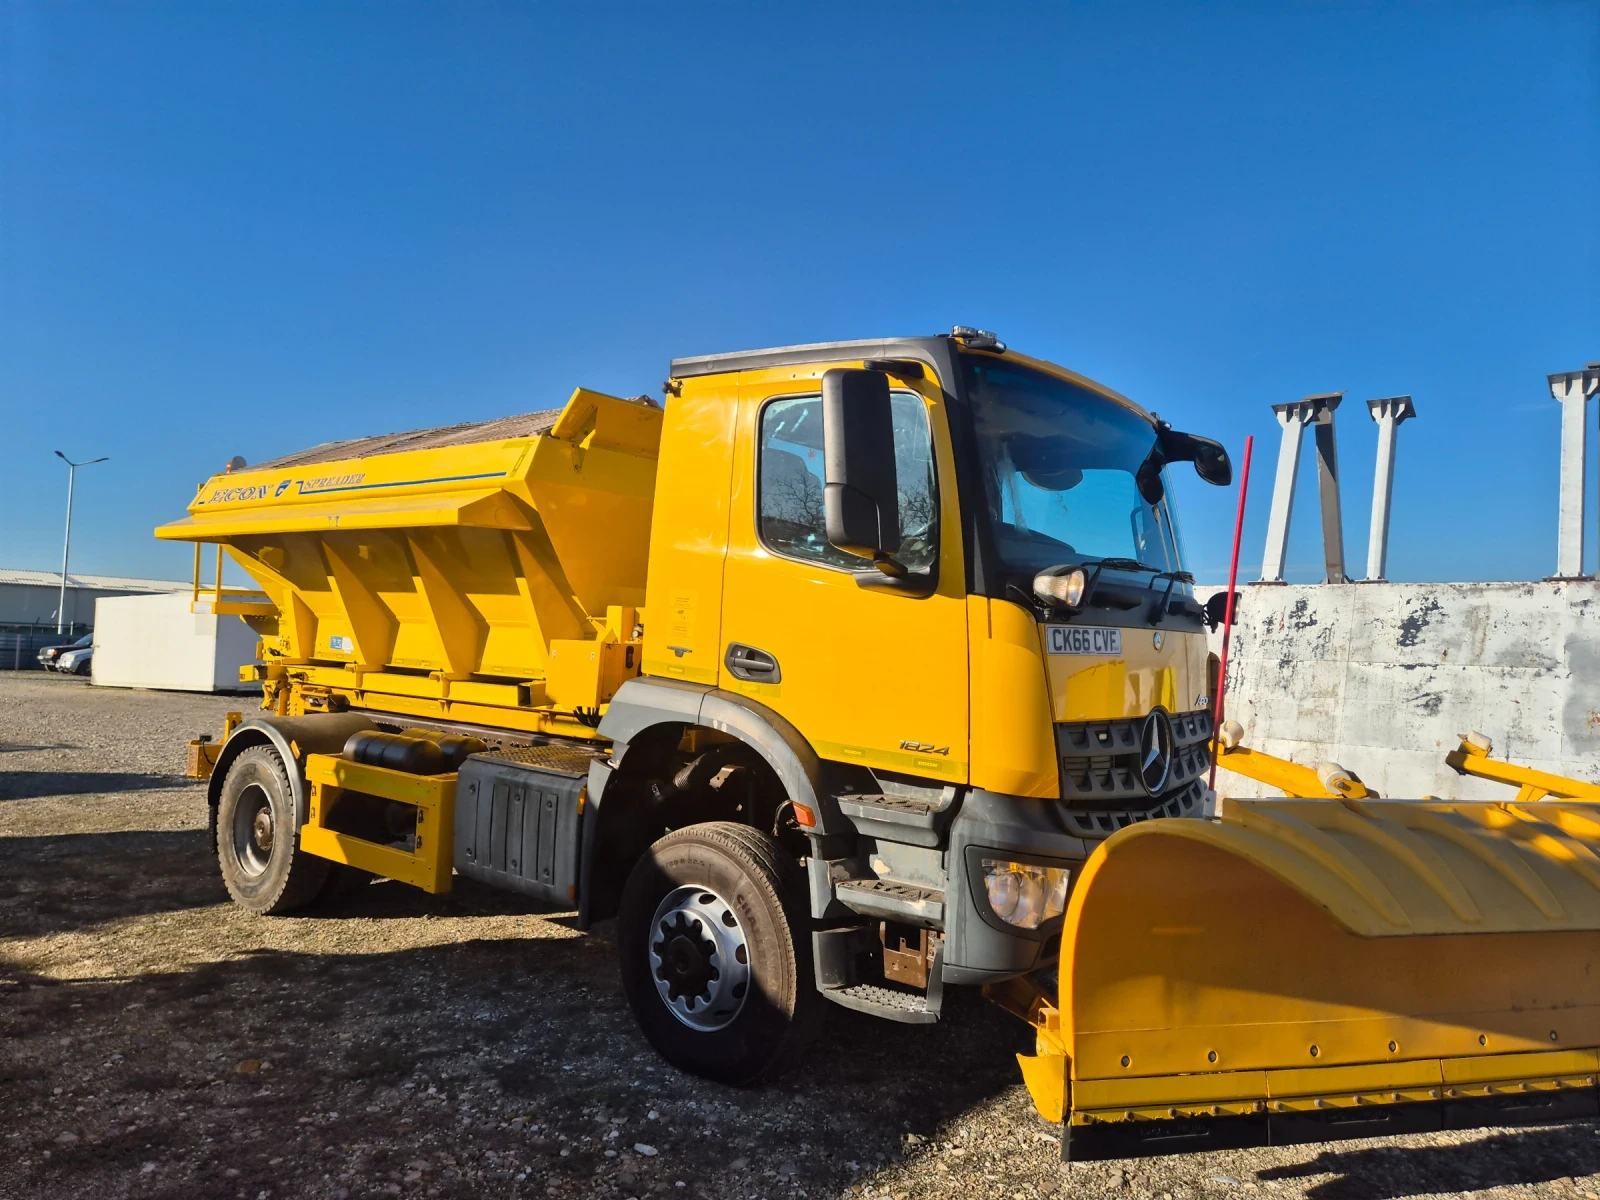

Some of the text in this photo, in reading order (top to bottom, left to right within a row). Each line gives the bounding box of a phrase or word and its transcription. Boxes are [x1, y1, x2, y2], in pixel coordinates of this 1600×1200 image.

[304, 473, 366, 489] SPREADER
[208, 485, 271, 504] ECON
[1052, 628, 1117, 652] CK66 CVF
[899, 739, 949, 757] 1824
